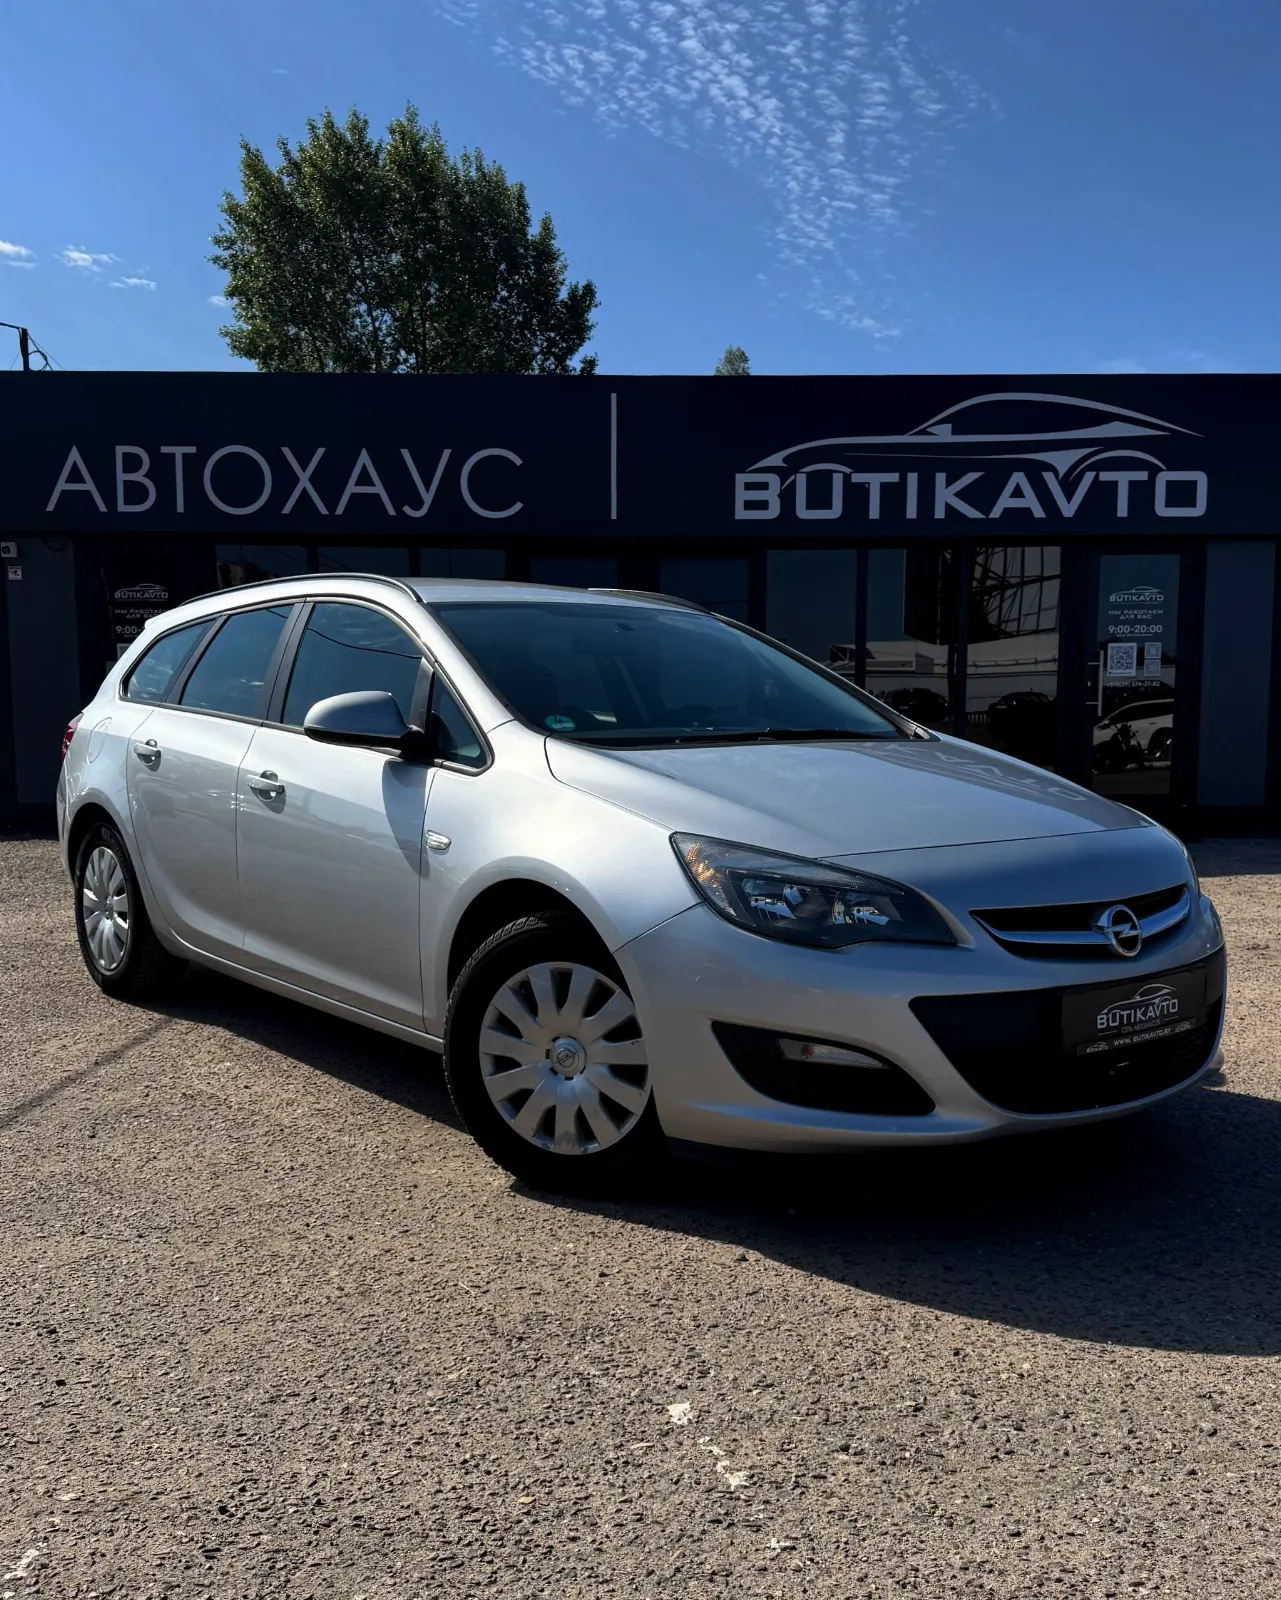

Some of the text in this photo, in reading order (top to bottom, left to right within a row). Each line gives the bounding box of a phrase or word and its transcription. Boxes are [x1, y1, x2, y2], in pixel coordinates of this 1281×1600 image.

[45, 443, 524, 519] АВТОХАУС
[734, 469, 1208, 521] BUTIKAVTO
[1108, 624, 1163, 634] 9:00-20:00
[1097, 998, 1178, 1029] BUTIKAVTO
